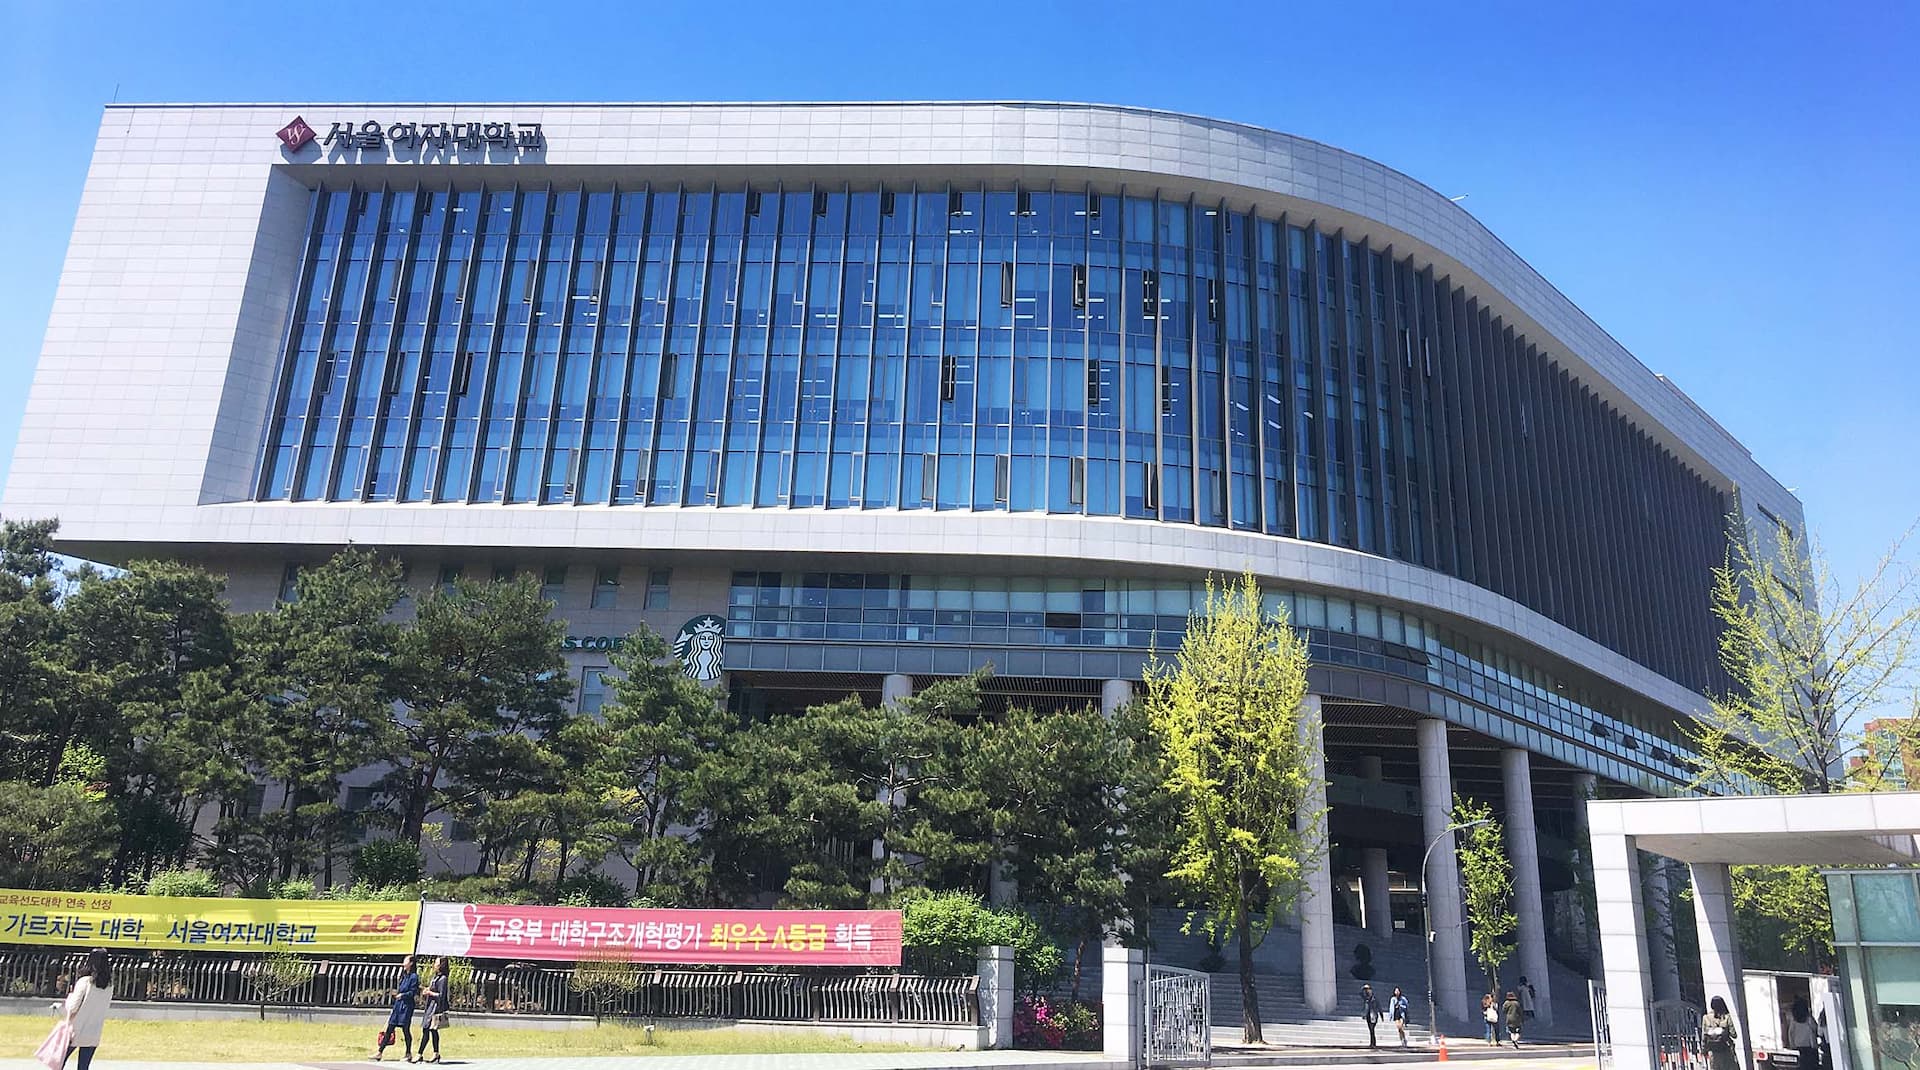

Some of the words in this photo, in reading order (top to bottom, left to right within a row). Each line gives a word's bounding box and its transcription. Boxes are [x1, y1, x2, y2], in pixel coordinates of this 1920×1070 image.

[323, 121, 542, 149] 서울여자대학교
[66, 898, 86, 909] 연속
[91, 899, 112, 910] 선정
[5, 913, 94, 939] 가르치는
[166, 920, 318, 946] 서울여자대학교
[349, 914, 410, 934] ACE
[485, 918, 543, 946] 교육부
[550, 919, 702, 950] 대학구조개혁평가
[708, 923, 768, 951] 최우수
[771, 923, 827, 951] A등급
[834, 923, 873, 951] 획득
